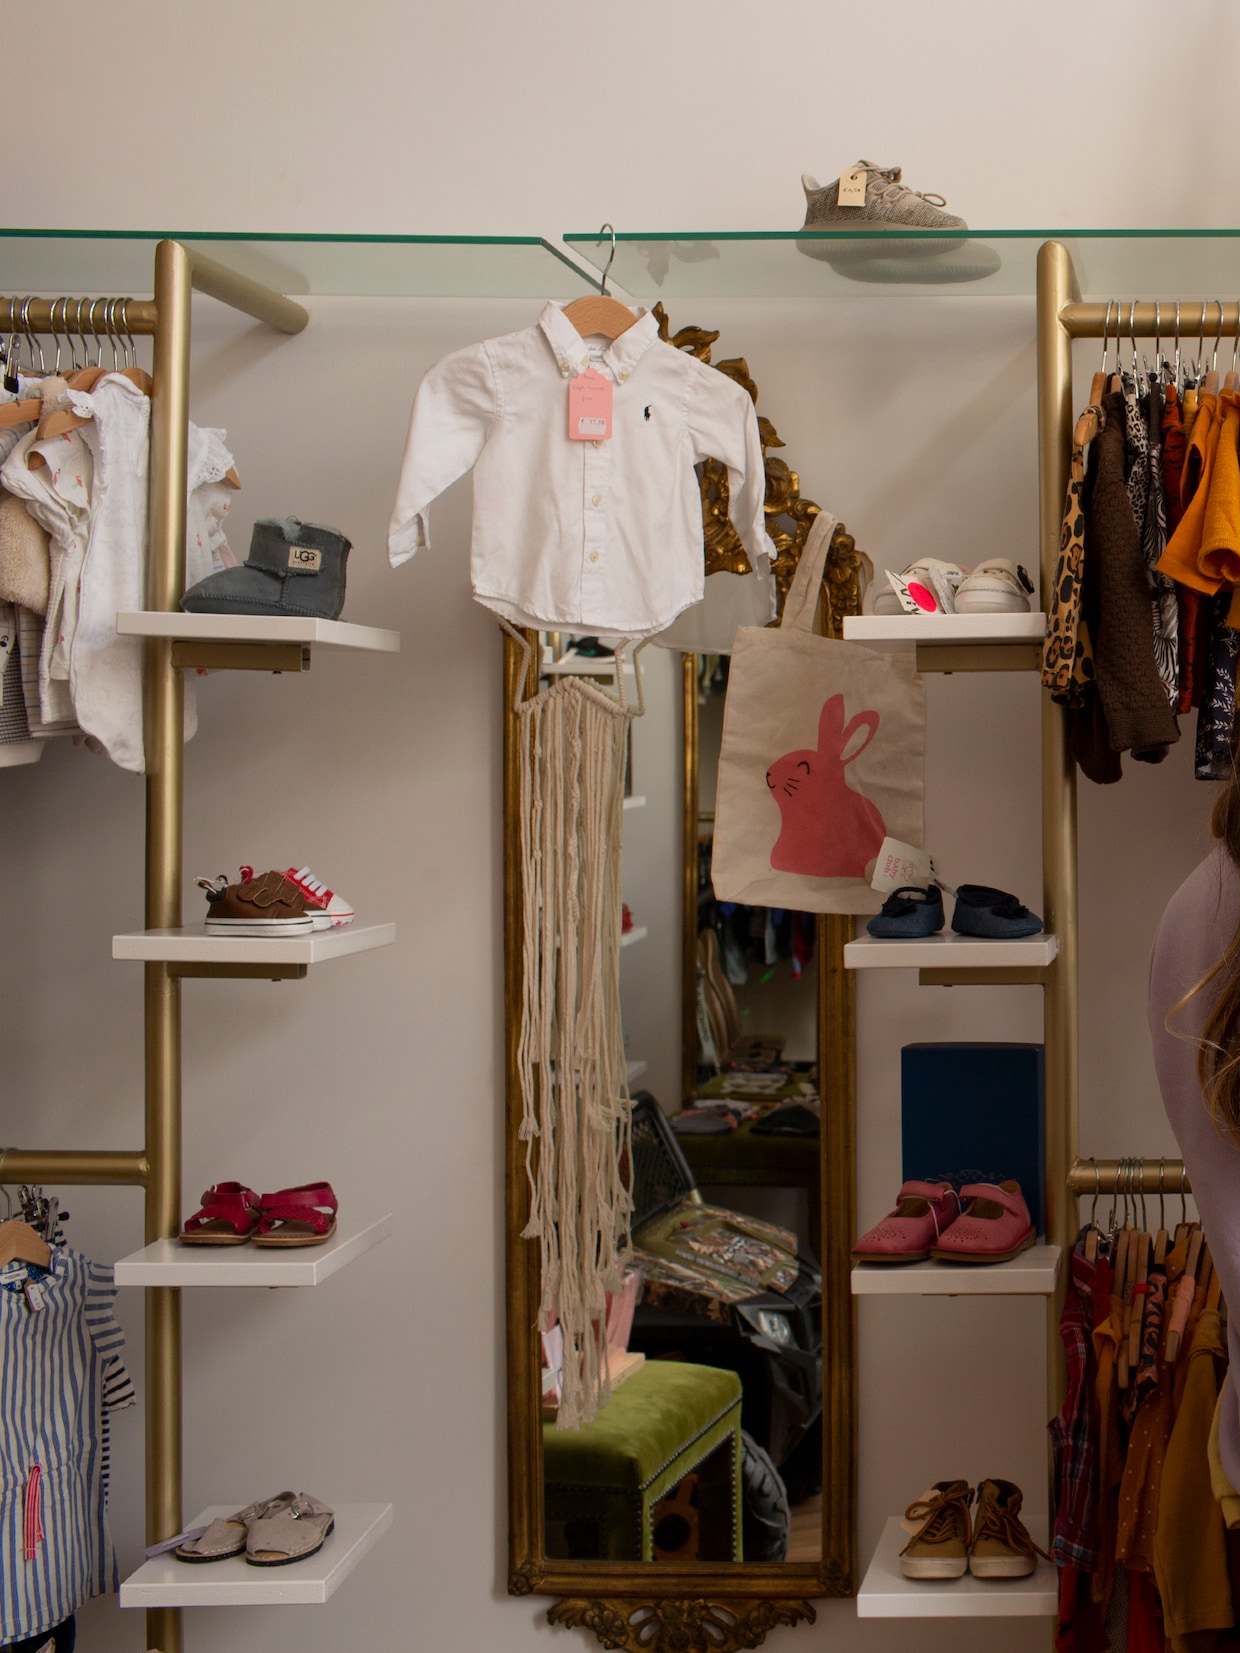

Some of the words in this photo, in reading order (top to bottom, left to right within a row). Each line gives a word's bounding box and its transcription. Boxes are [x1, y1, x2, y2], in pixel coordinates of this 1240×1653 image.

[294, 550, 315, 562] UGG
[884, 855, 893, 874] club
[889, 857, 901, 880] baby
